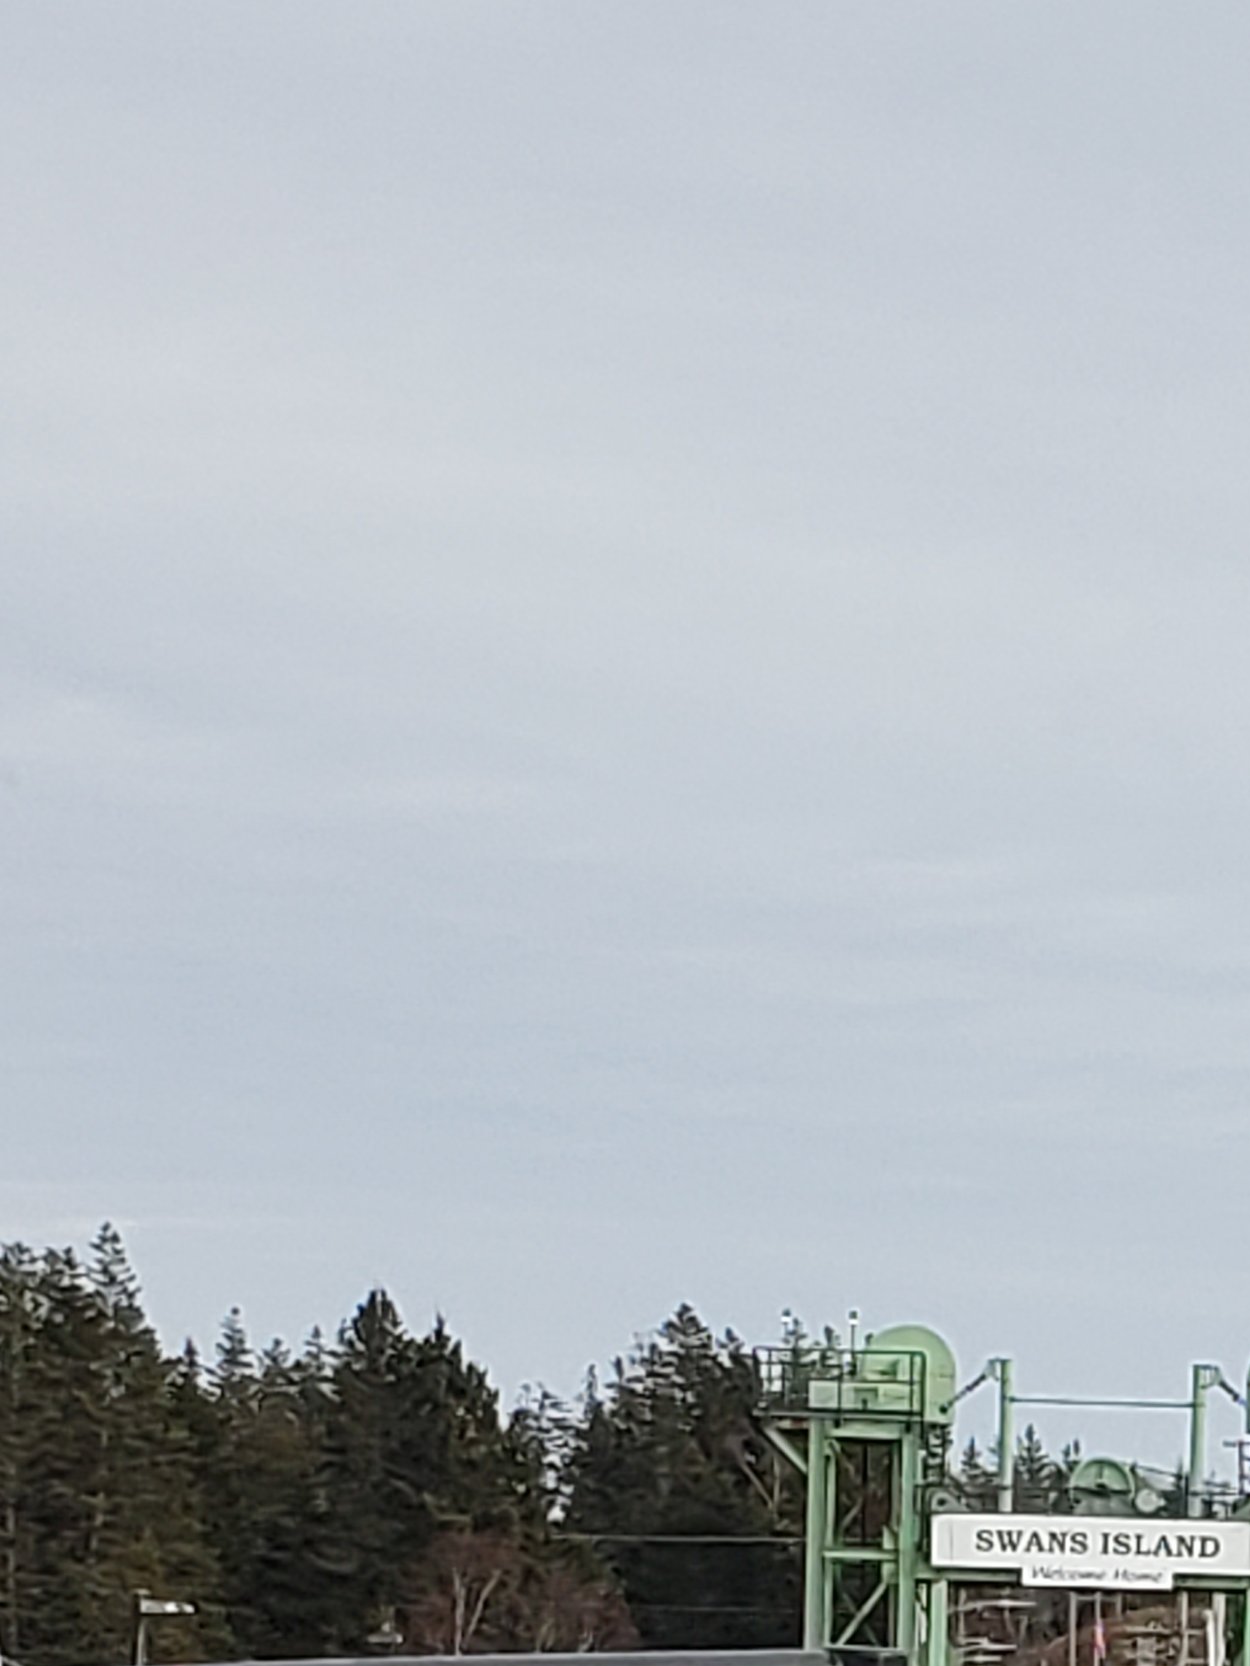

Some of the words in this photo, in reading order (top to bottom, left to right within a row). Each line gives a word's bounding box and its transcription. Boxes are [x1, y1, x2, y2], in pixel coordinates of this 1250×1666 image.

[975, 1528, 1089, 1553] SWANS
[1100, 1532, 1222, 1559] ISLAND
[1031, 1565, 1107, 1581] Welcome
